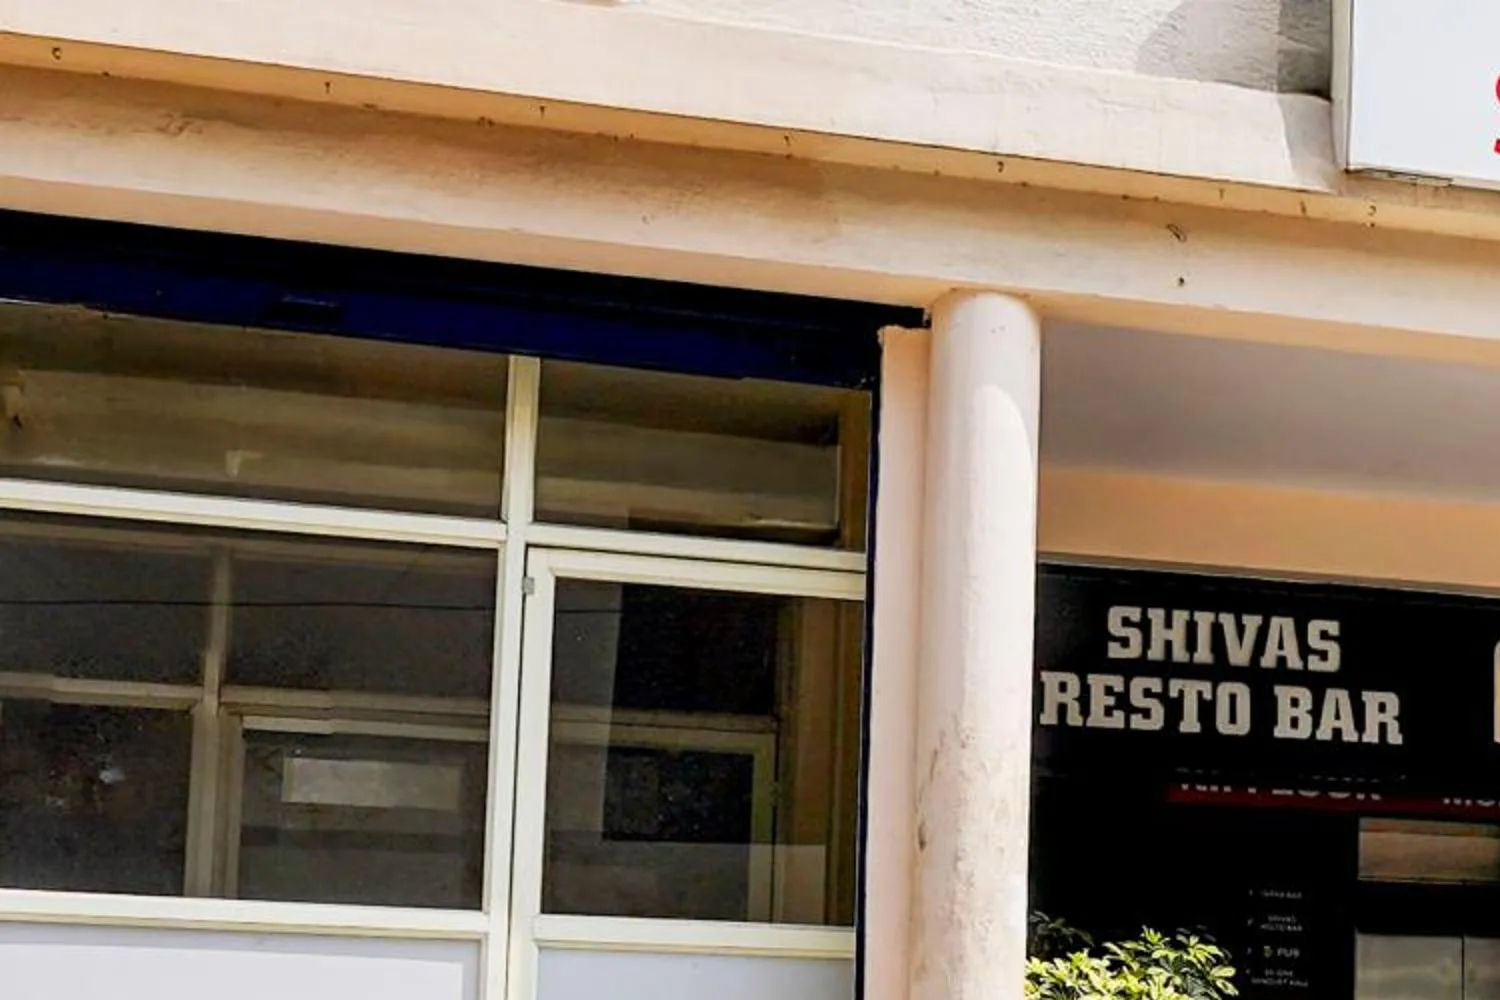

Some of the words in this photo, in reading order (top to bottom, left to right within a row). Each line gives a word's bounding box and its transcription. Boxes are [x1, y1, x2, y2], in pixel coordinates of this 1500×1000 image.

[1106, 604, 1342, 673] SHIVAS
[1039, 670, 1252, 737] RESTO
[1273, 684, 1403, 745] BAR
